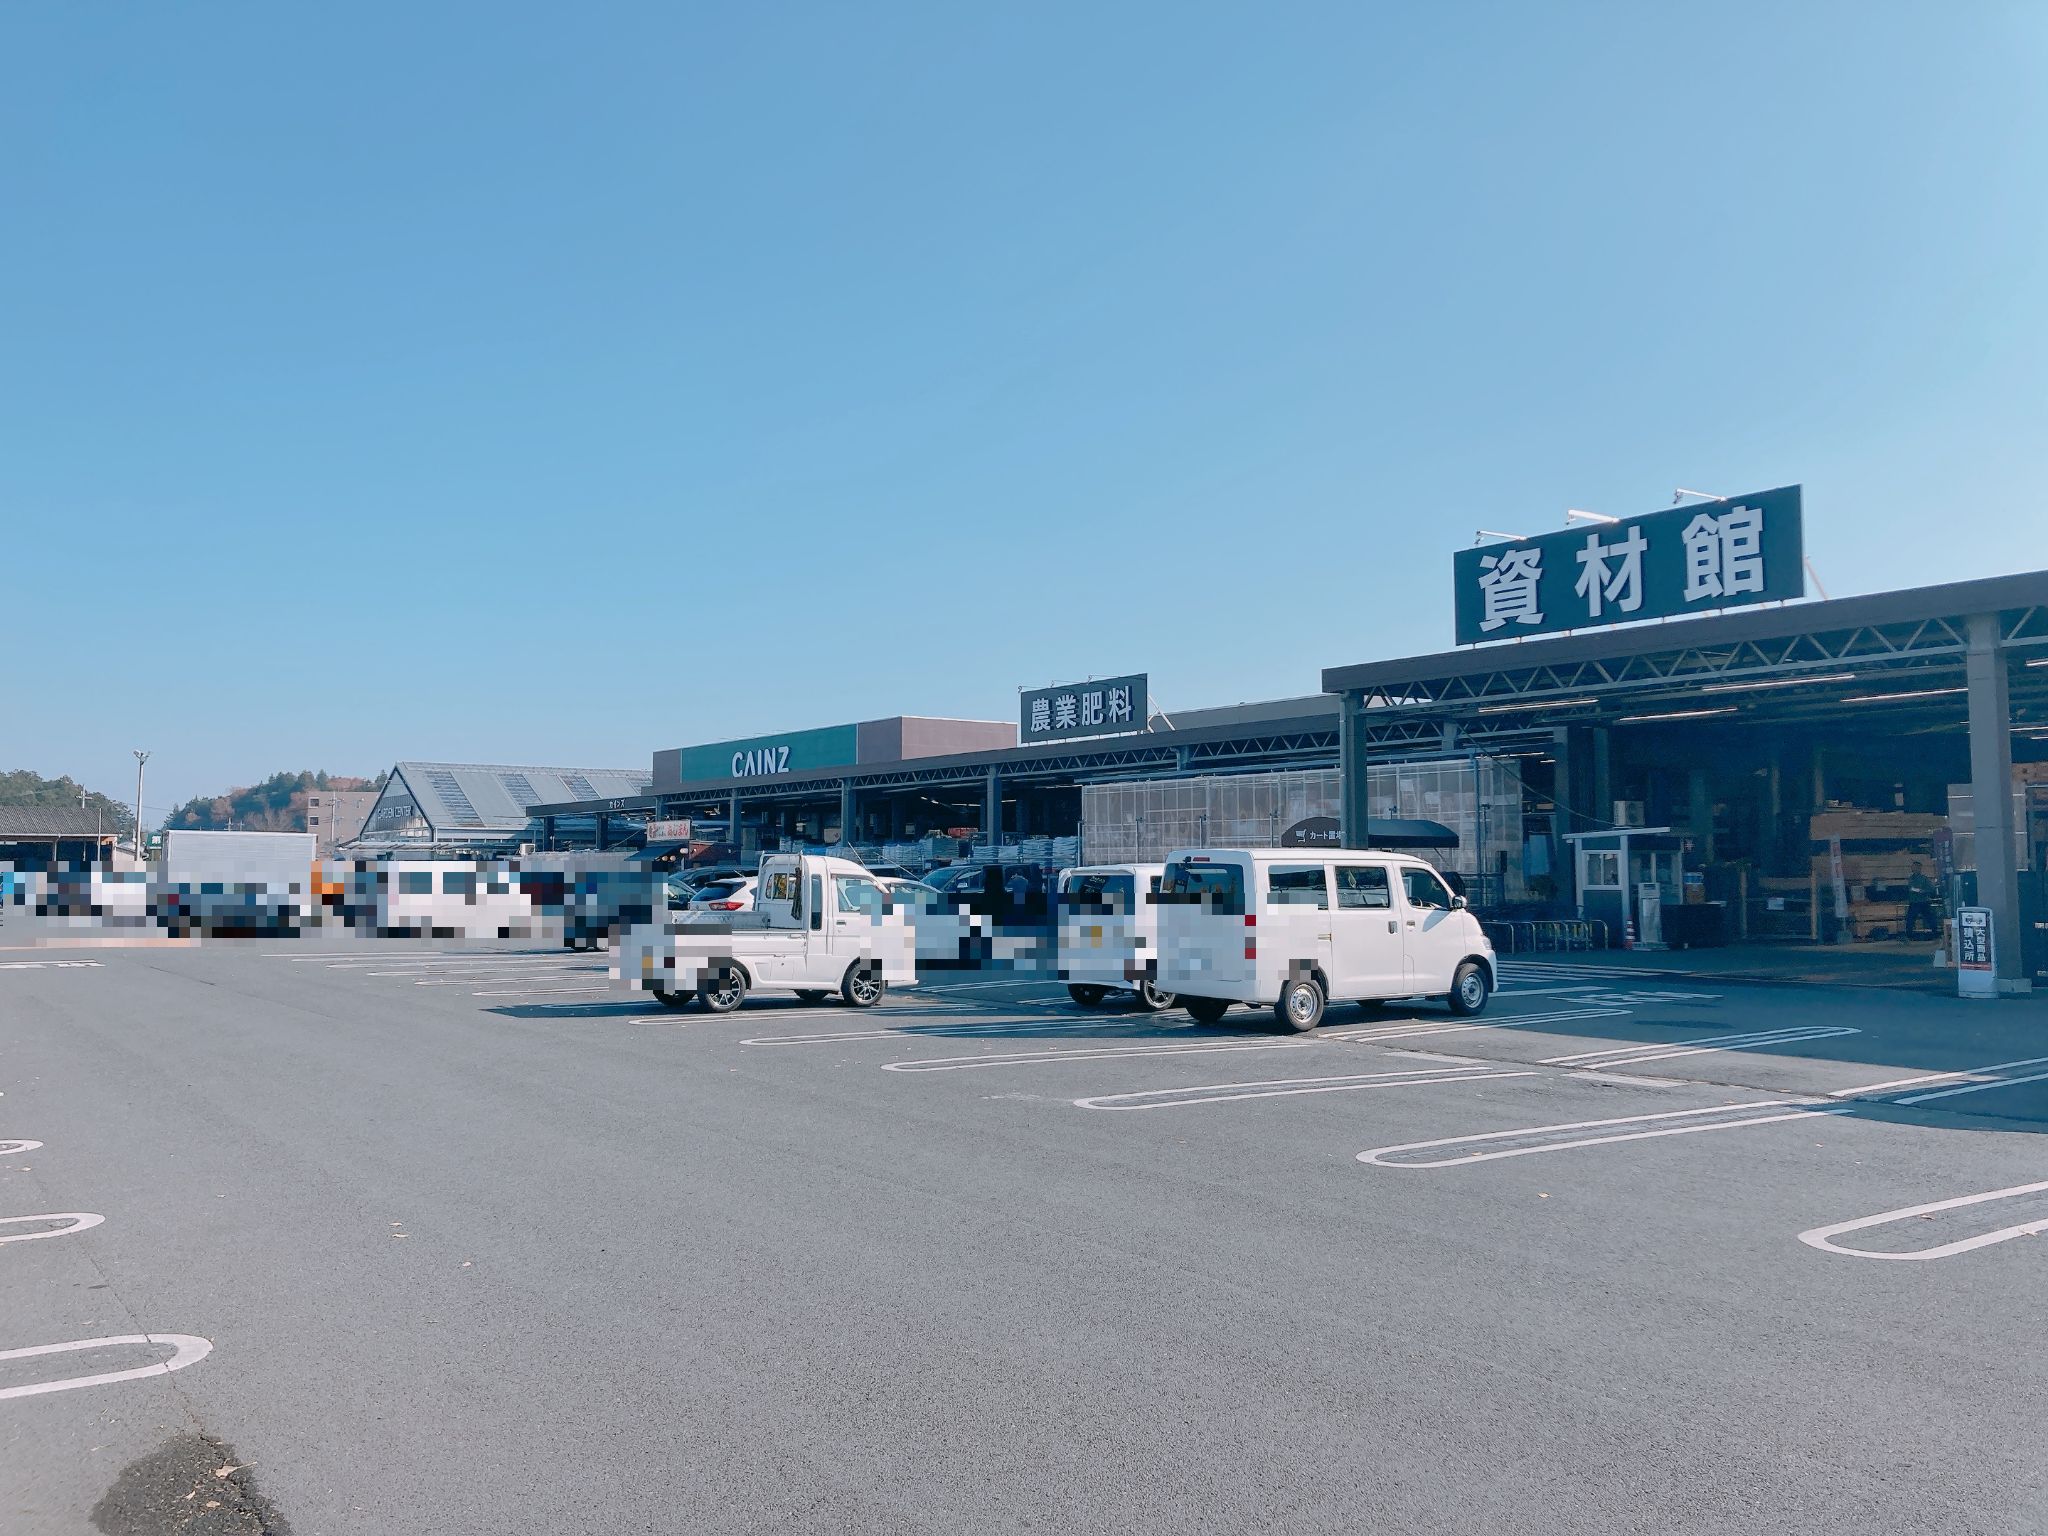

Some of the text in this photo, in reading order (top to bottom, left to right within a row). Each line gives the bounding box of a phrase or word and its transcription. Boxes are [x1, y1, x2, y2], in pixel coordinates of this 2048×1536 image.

[1478, 505, 1763, 632] 資材館
[1030, 685, 1132, 733] 農業肥料
[731, 746, 789, 777] CAINZ
[609, 799, 625, 809] カインズ
[1975, 928, 1986, 962] 大型商品
